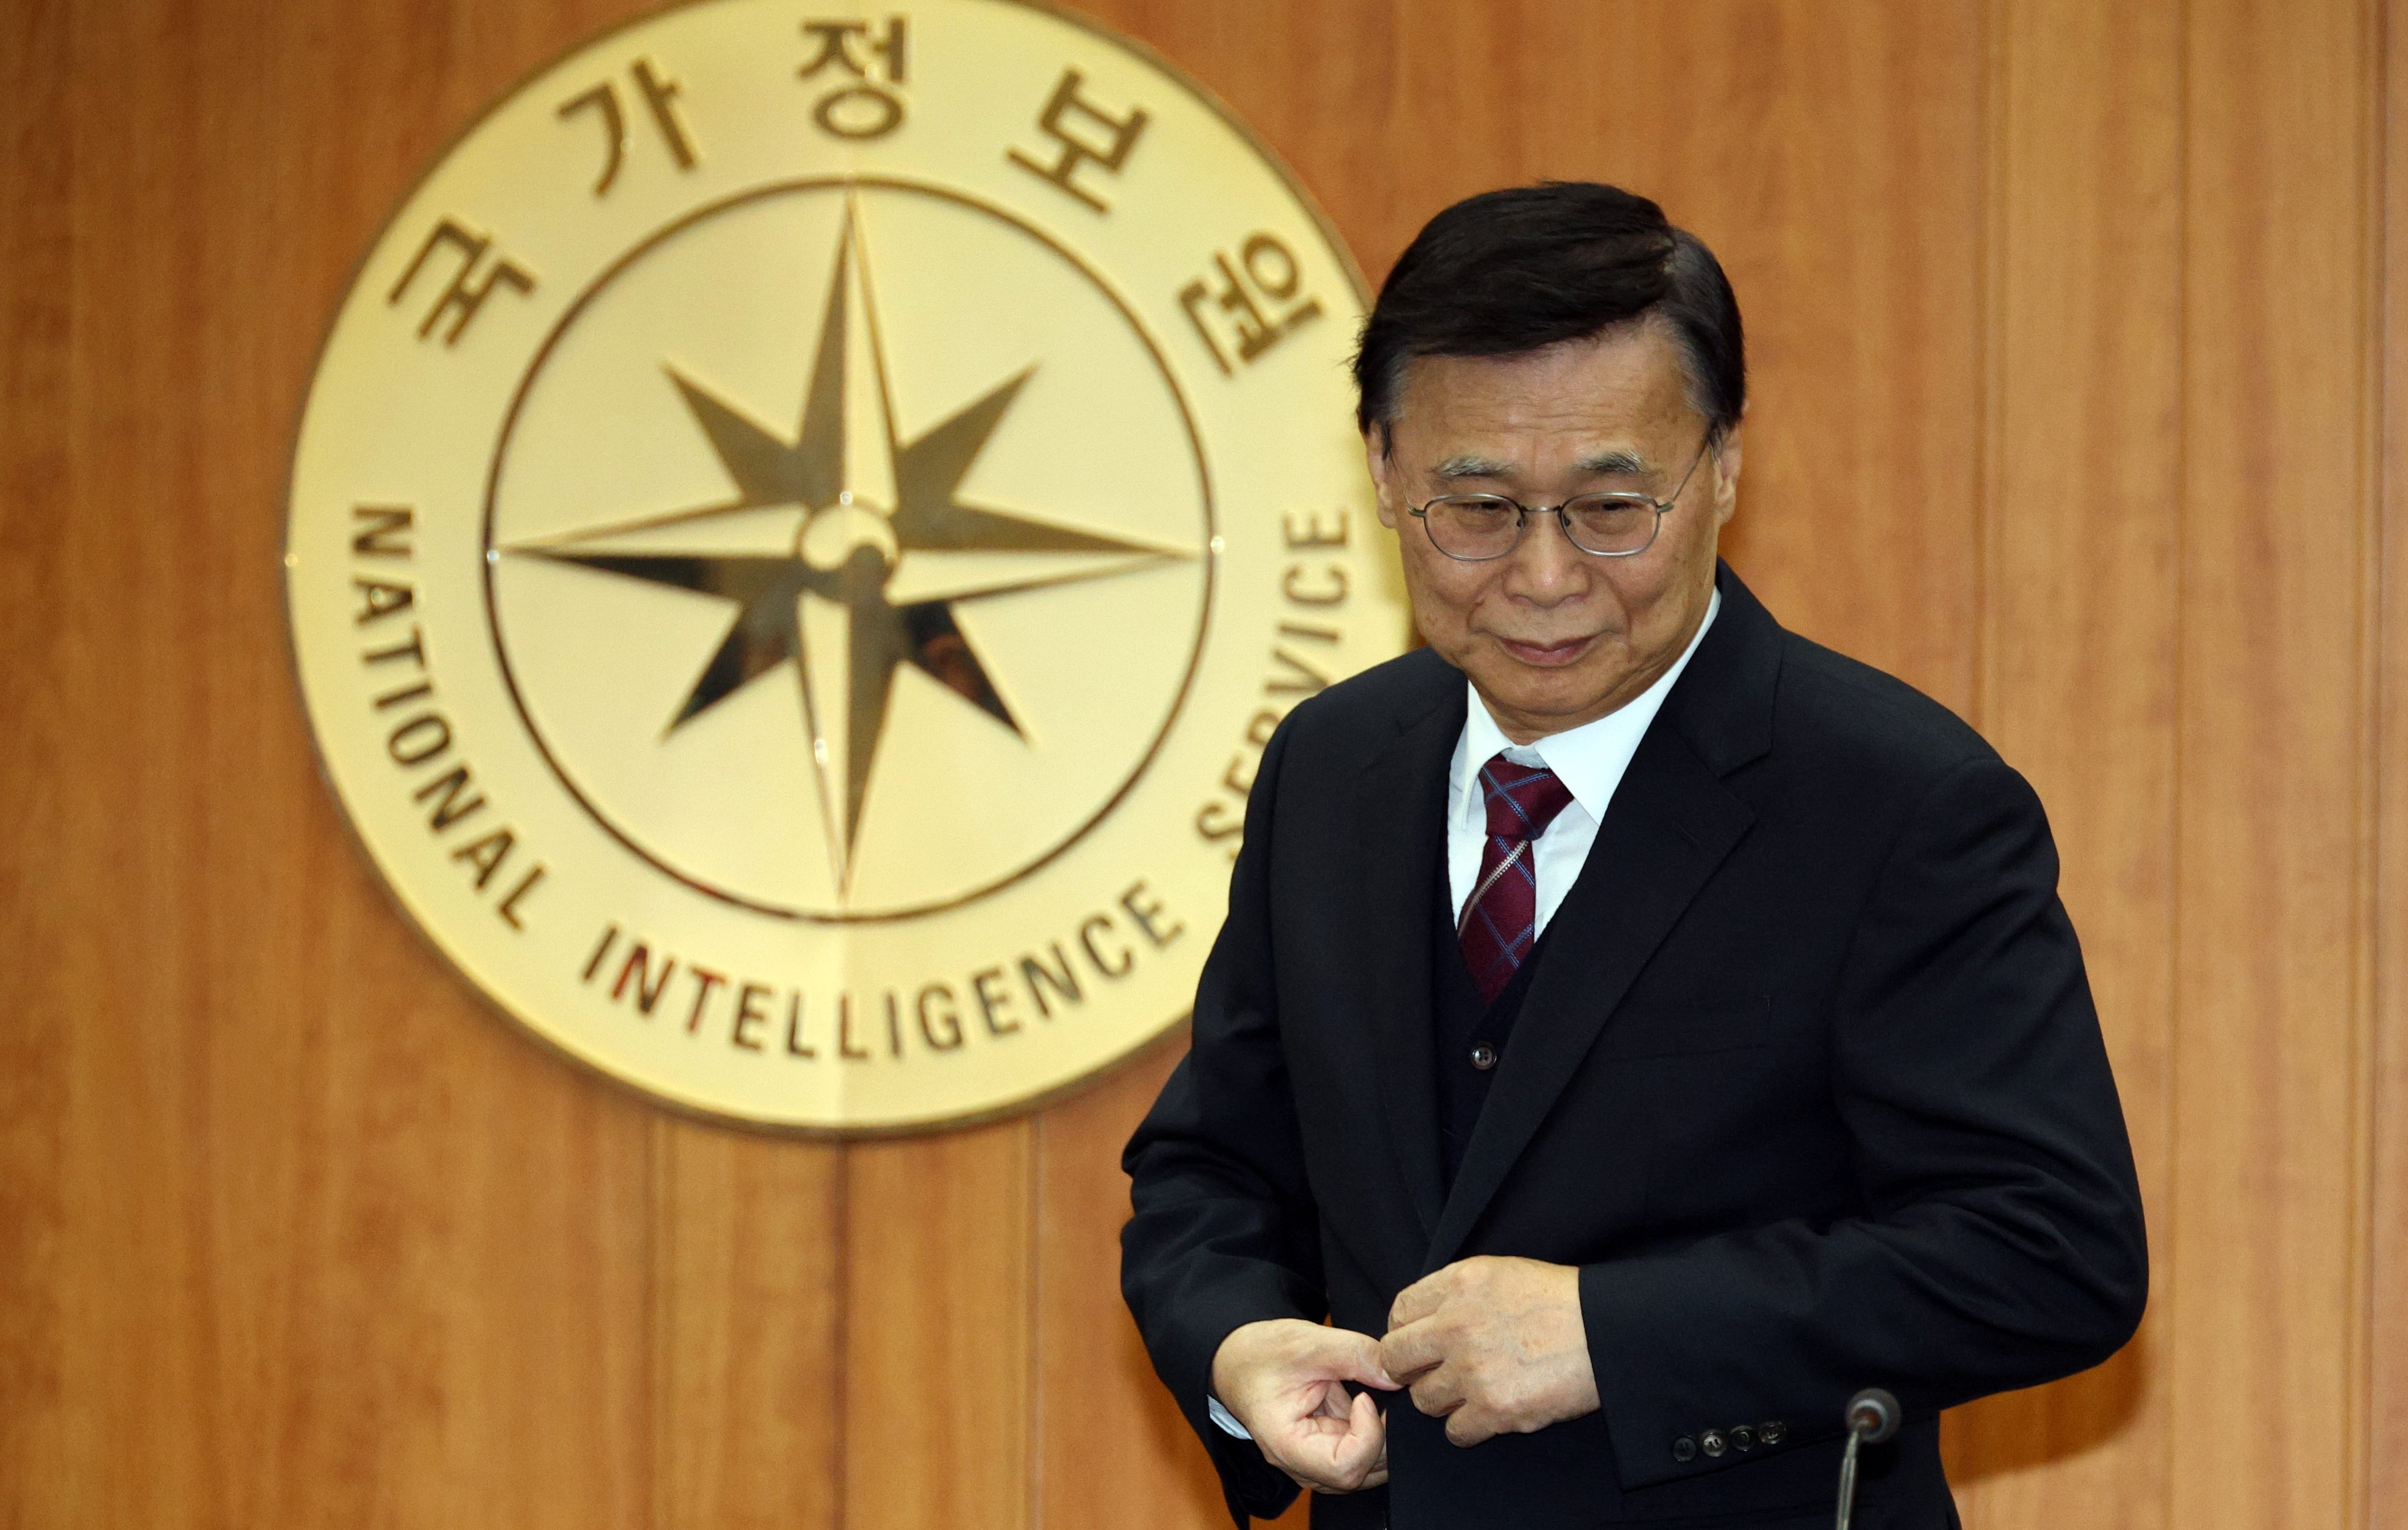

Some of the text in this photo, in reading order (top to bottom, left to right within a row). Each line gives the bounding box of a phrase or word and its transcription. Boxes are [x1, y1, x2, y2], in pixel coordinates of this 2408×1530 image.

[388, 17, 1328, 377] 국가정보원
[353, 502, 547, 932] NATIONAL
[580, 881, 1185, 1059] INTELLIGENCE
